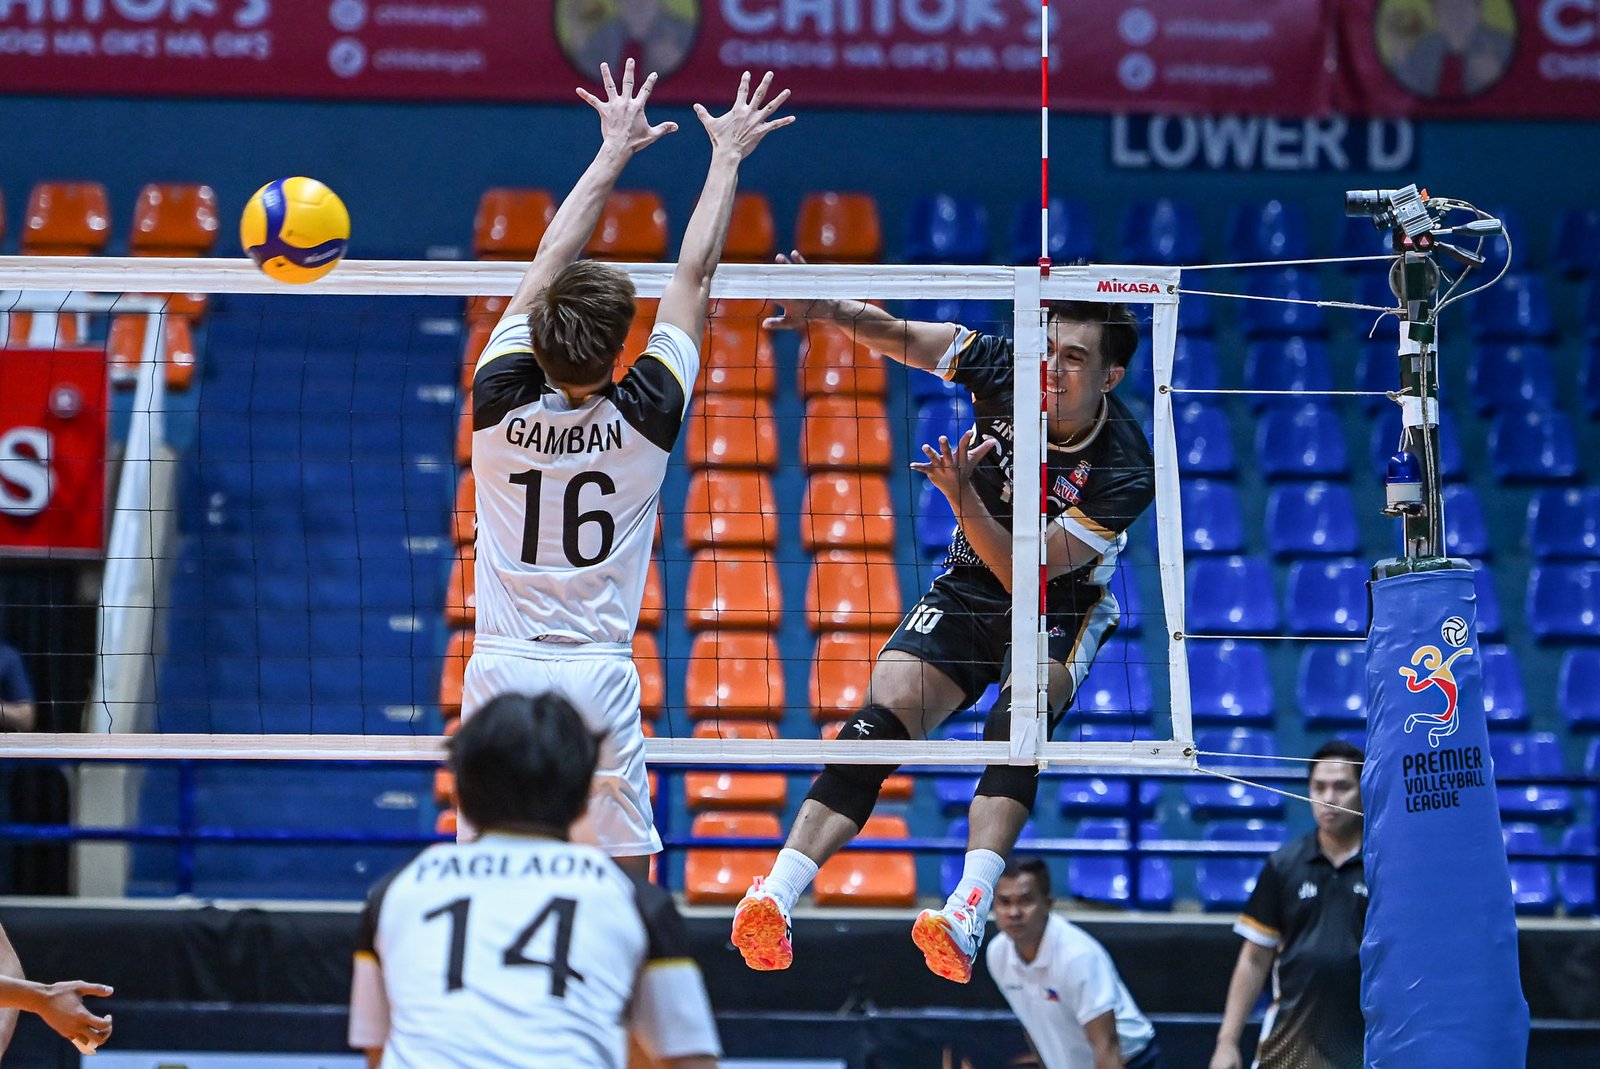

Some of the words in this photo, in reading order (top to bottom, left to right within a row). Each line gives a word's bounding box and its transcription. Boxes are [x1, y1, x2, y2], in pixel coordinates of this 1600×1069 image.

[1538, 0, 1600, 46] C
[1110, 113, 1349, 171] LOWER
[1367, 117, 1416, 171] D
[505, 417, 623, 455] GAMBAN
[508, 469, 616, 567] 16
[905, 604, 943, 635] 10
[1403, 747, 1483, 777] PREMIER
[1404, 770, 1485, 795] VOLLEYBALL
[1406, 791, 1460, 813] LEAGUE
[415, 853, 608, 884] PAGLAON
[423, 896, 585, 998] 14
